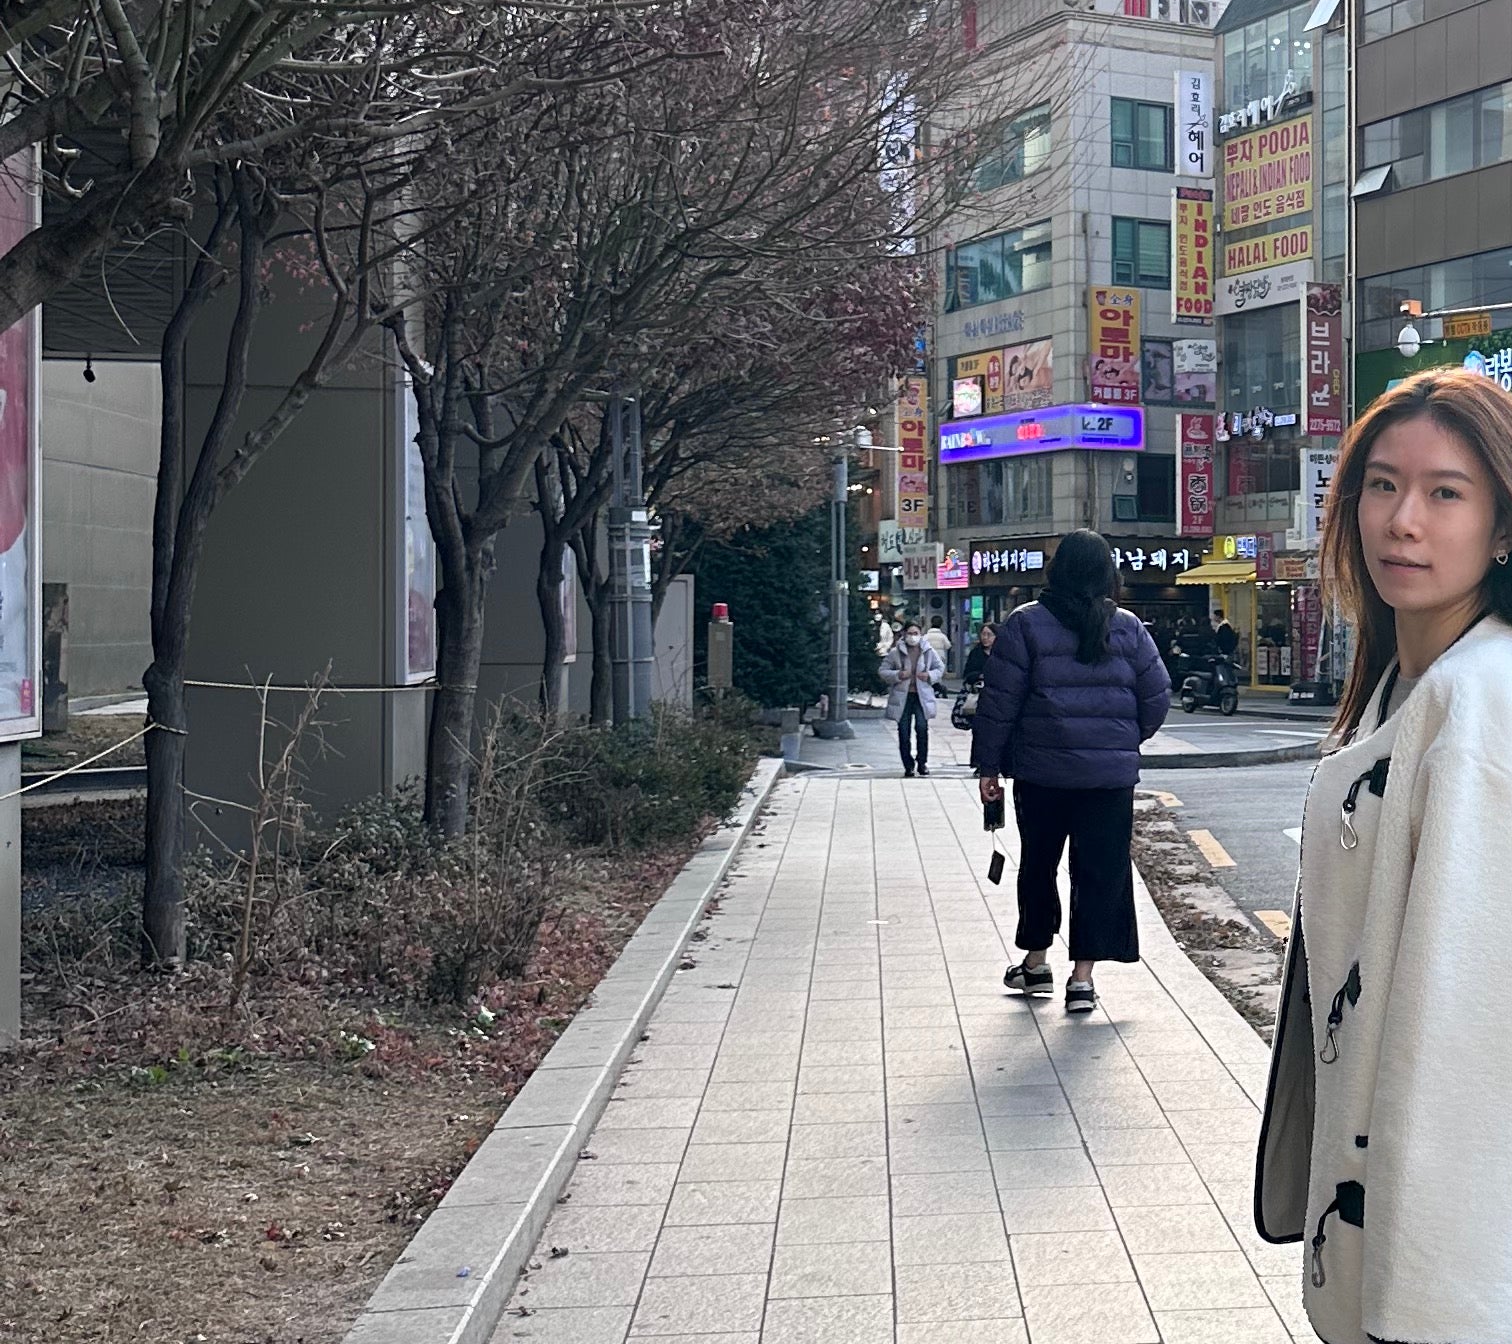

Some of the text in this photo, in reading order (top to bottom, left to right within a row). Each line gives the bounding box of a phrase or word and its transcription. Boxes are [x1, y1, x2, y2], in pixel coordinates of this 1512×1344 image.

[1188, 129, 1204, 173] 헤어
[1258, 121, 1310, 159] POOJA
[1289, 151, 1311, 186] FOOD
[1231, 188, 1306, 225] 네팔 인도 음식점
[1192, 203, 1209, 295] INDIAN
[1227, 230, 1309, 270] HALAL FOOD
[1177, 297, 1213, 315] FOOD
[1099, 308, 1135, 364] 아로마
[1124, 388, 1138, 401] 3F
[1097, 418, 1113, 431] 2F
[901, 498, 924, 512] 3F
